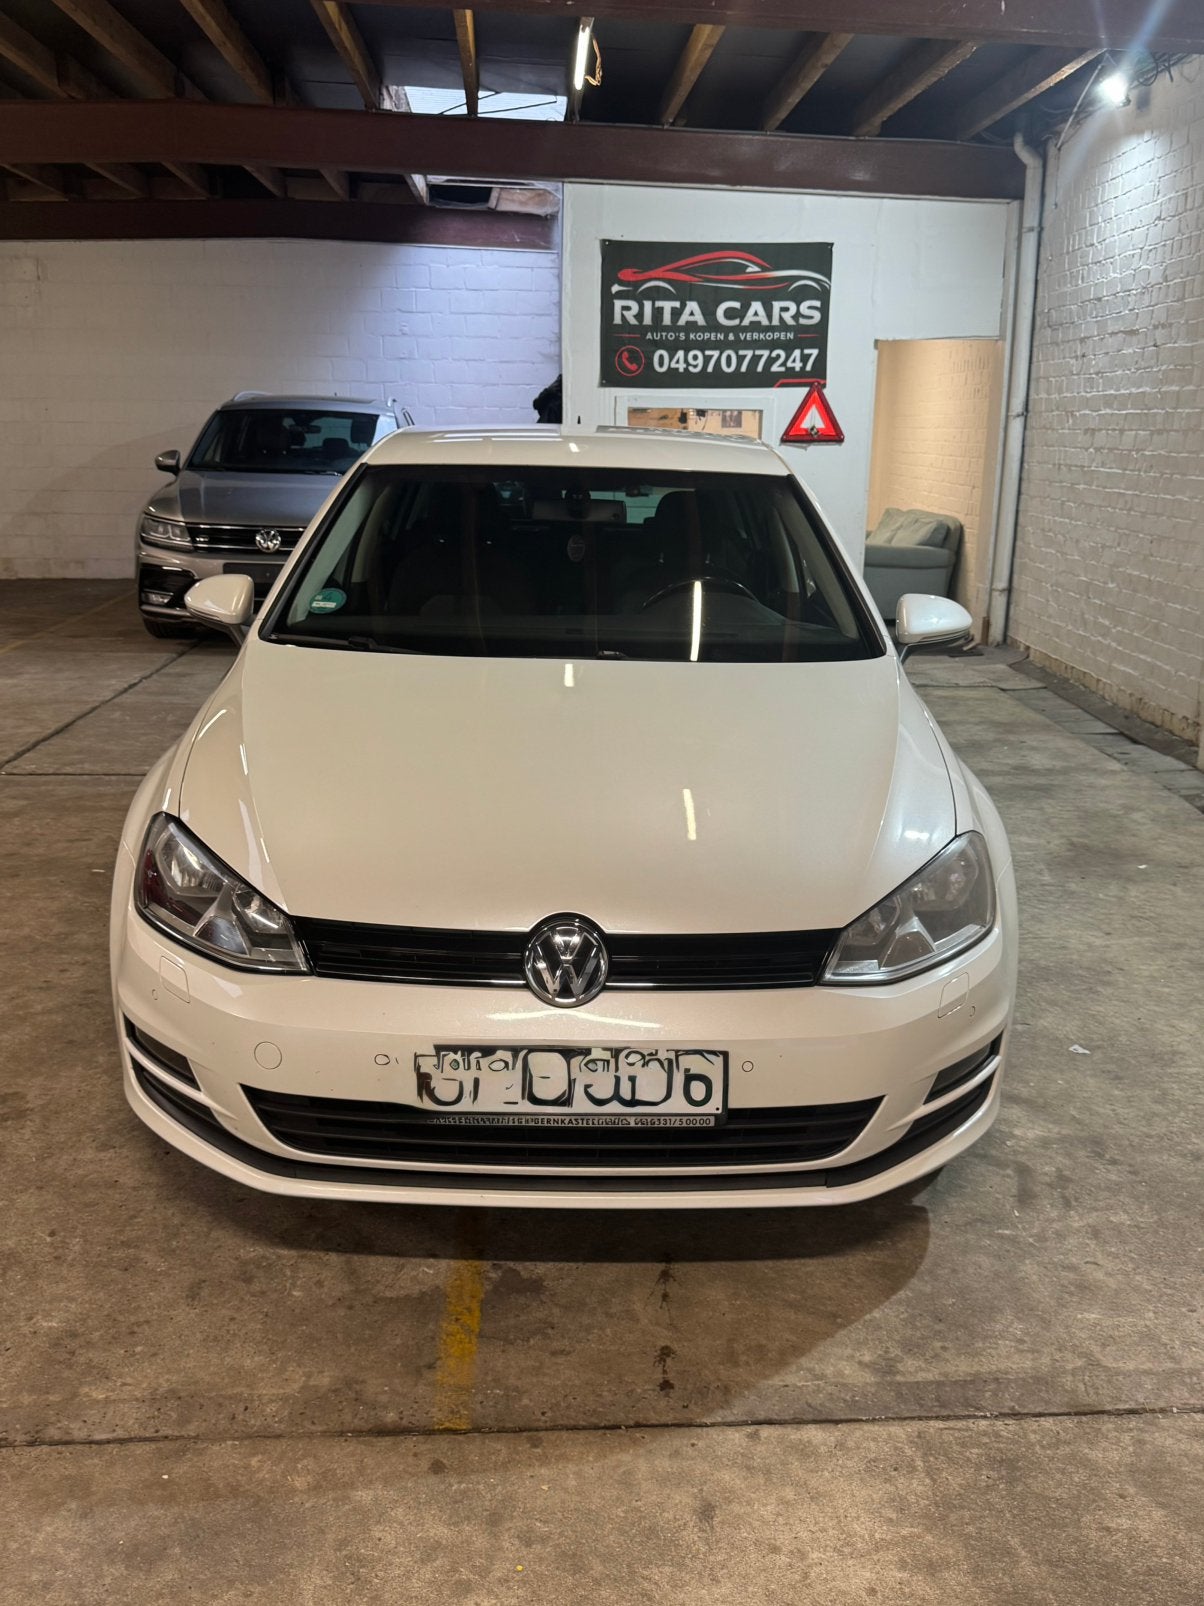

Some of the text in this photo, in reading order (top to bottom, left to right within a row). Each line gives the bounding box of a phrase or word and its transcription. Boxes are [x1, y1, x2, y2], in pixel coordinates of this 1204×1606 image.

[612, 300, 822, 327] RITA CARS
[645, 331, 795, 341] AUTO'S KOPEN & VERKOPEN
[652, 348, 820, 373] 0497077247
